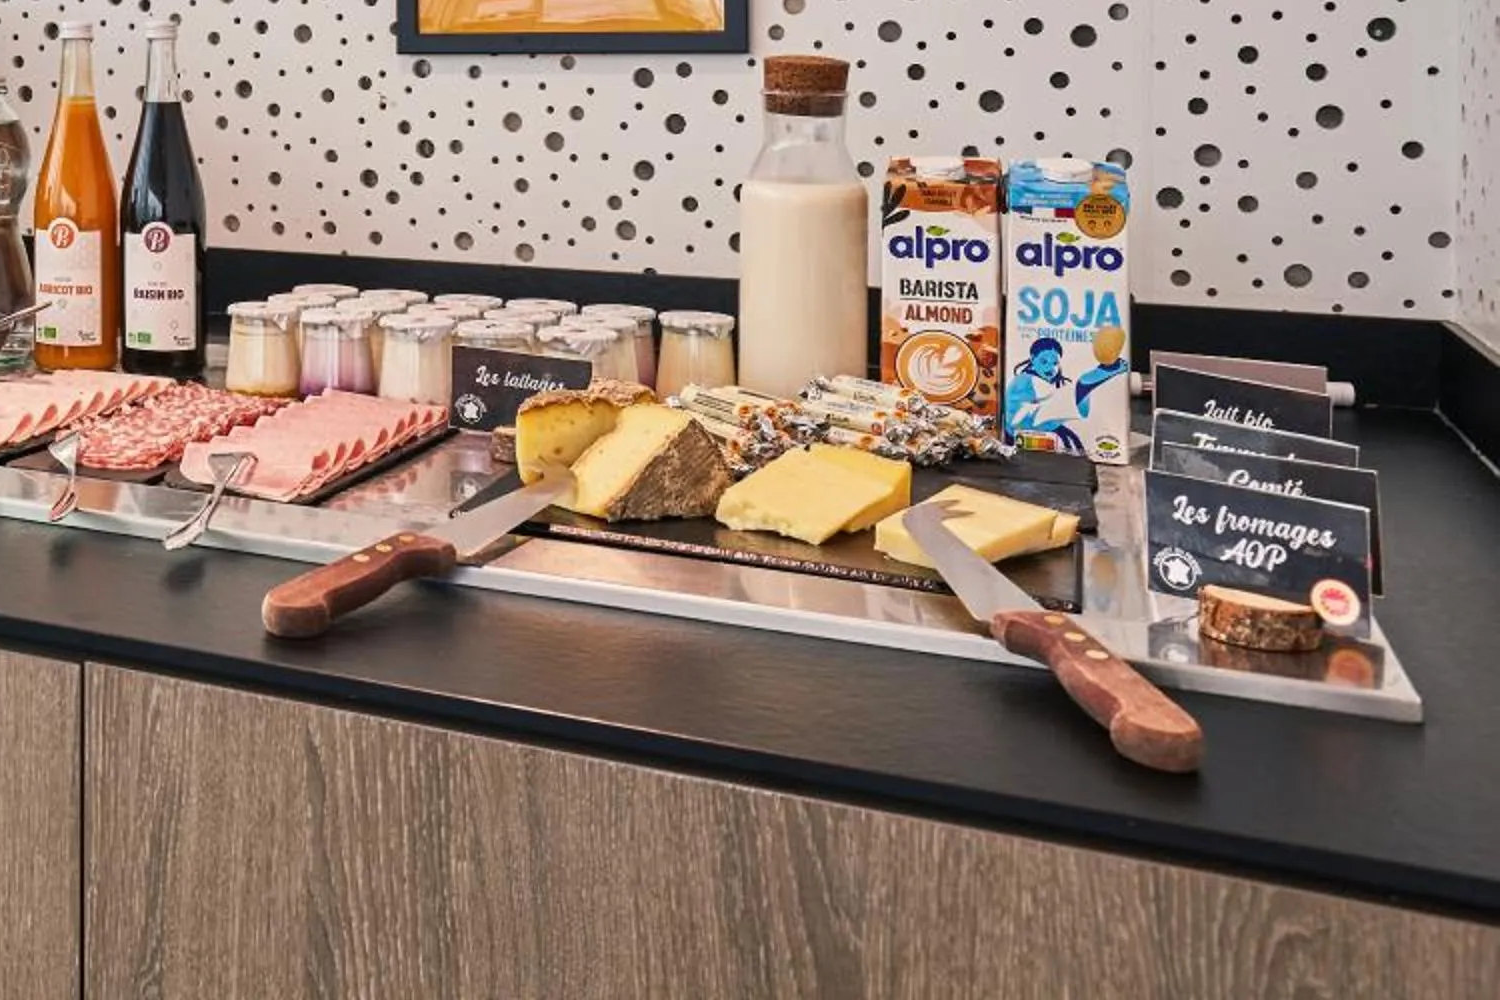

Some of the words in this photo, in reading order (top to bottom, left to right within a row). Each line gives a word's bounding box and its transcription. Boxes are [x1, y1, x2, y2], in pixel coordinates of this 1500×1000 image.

[889, 226, 990, 269] alpro
[1016, 232, 1123, 277] alpro
[900, 278, 979, 300] BARISTA
[1017, 286, 1121, 328] SOJA
[905, 304, 973, 325] ALMOND
[1203, 400, 1239, 424] Lait
[1243, 409, 1275, 431] bio
[1172, 496, 1211, 526] Les
[1215, 506, 1337, 550] fromages
[1220, 538, 1287, 571] AOP
